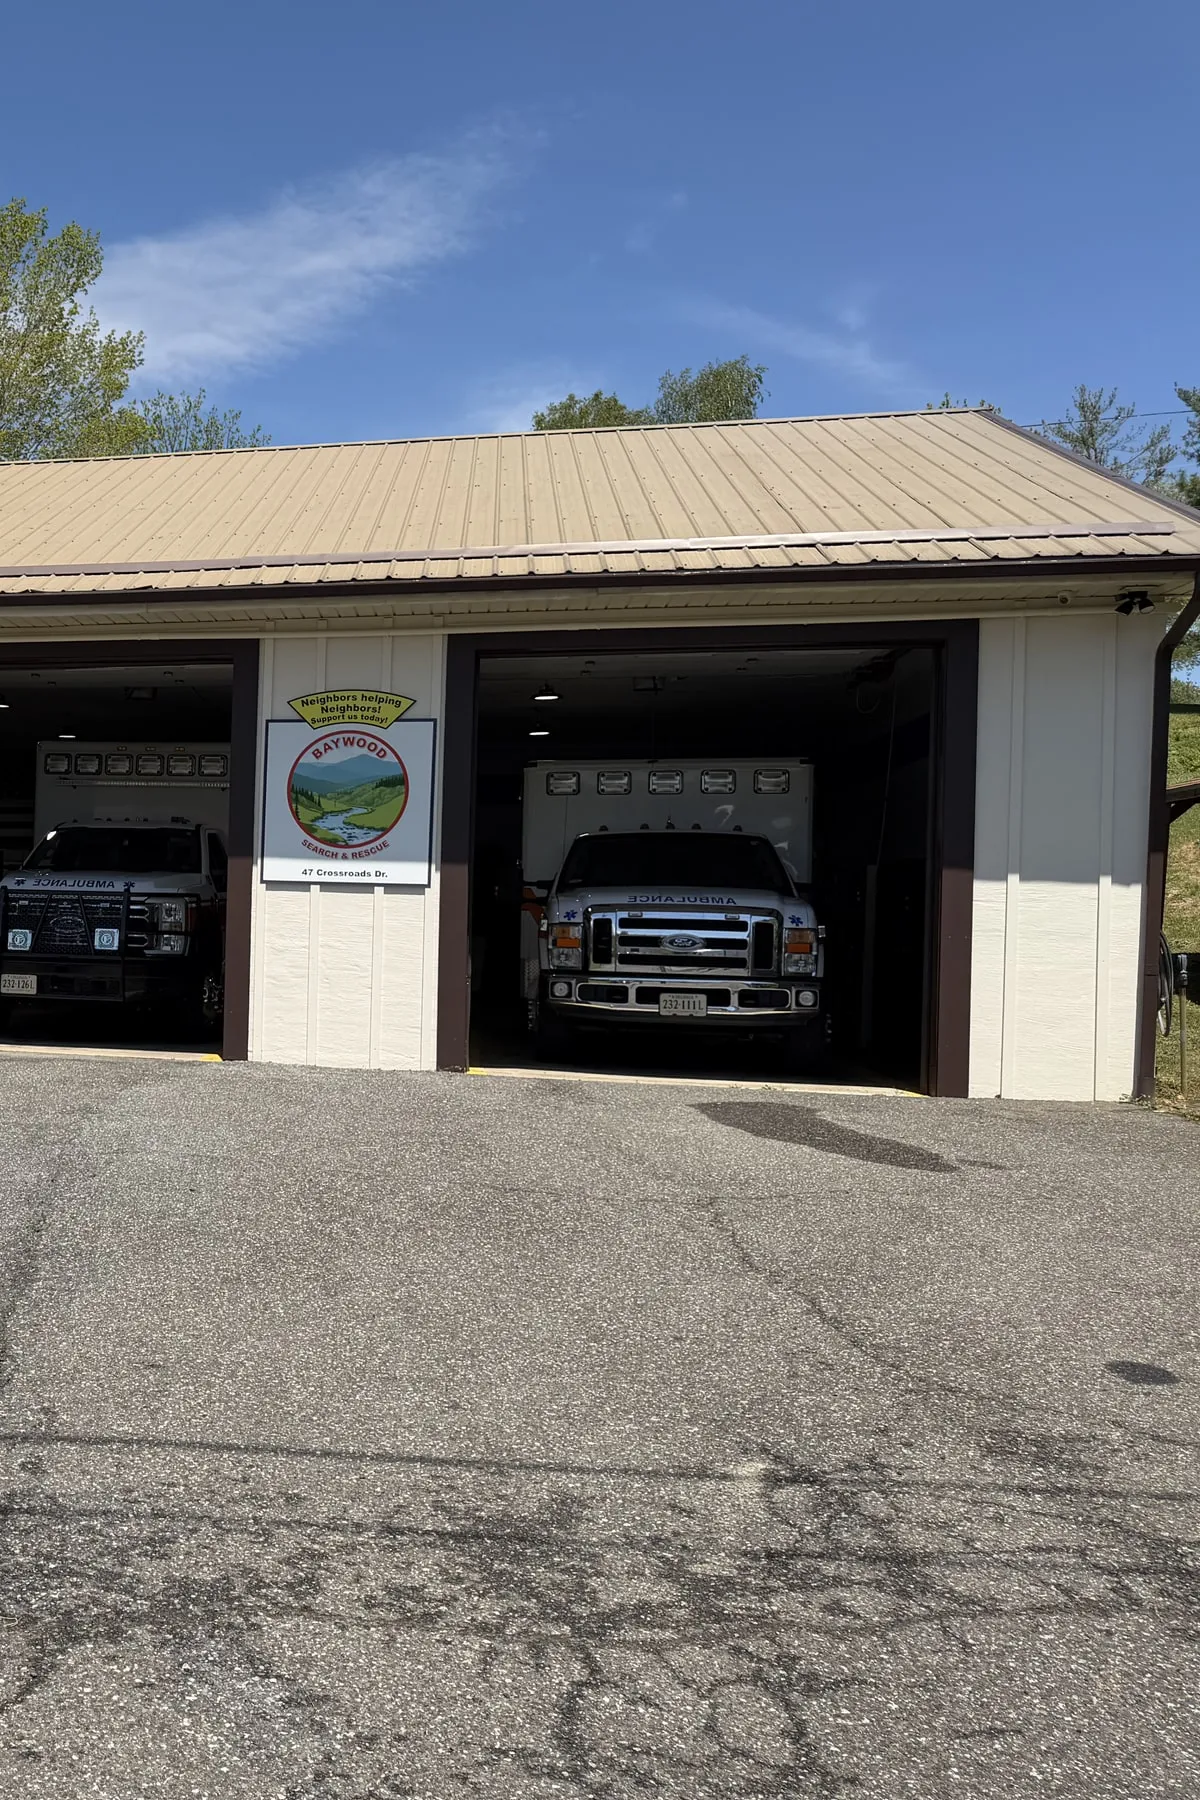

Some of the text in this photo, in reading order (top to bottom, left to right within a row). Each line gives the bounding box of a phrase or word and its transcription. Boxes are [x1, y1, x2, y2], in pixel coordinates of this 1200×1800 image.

[301, 693, 402, 708] Neighbors helping
[320, 704, 382, 714] Neighbors!
[311, 713, 345, 724] Support
[361, 714, 388, 723] today!
[311, 736, 388, 760] BAYWOOD
[301, 839, 339, 859] SEARCH
[351, 840, 390, 860] RESCUE
[301, 868, 388, 878] 47 Crossroads Dr.
[672, 938, 693, 947] Ford
